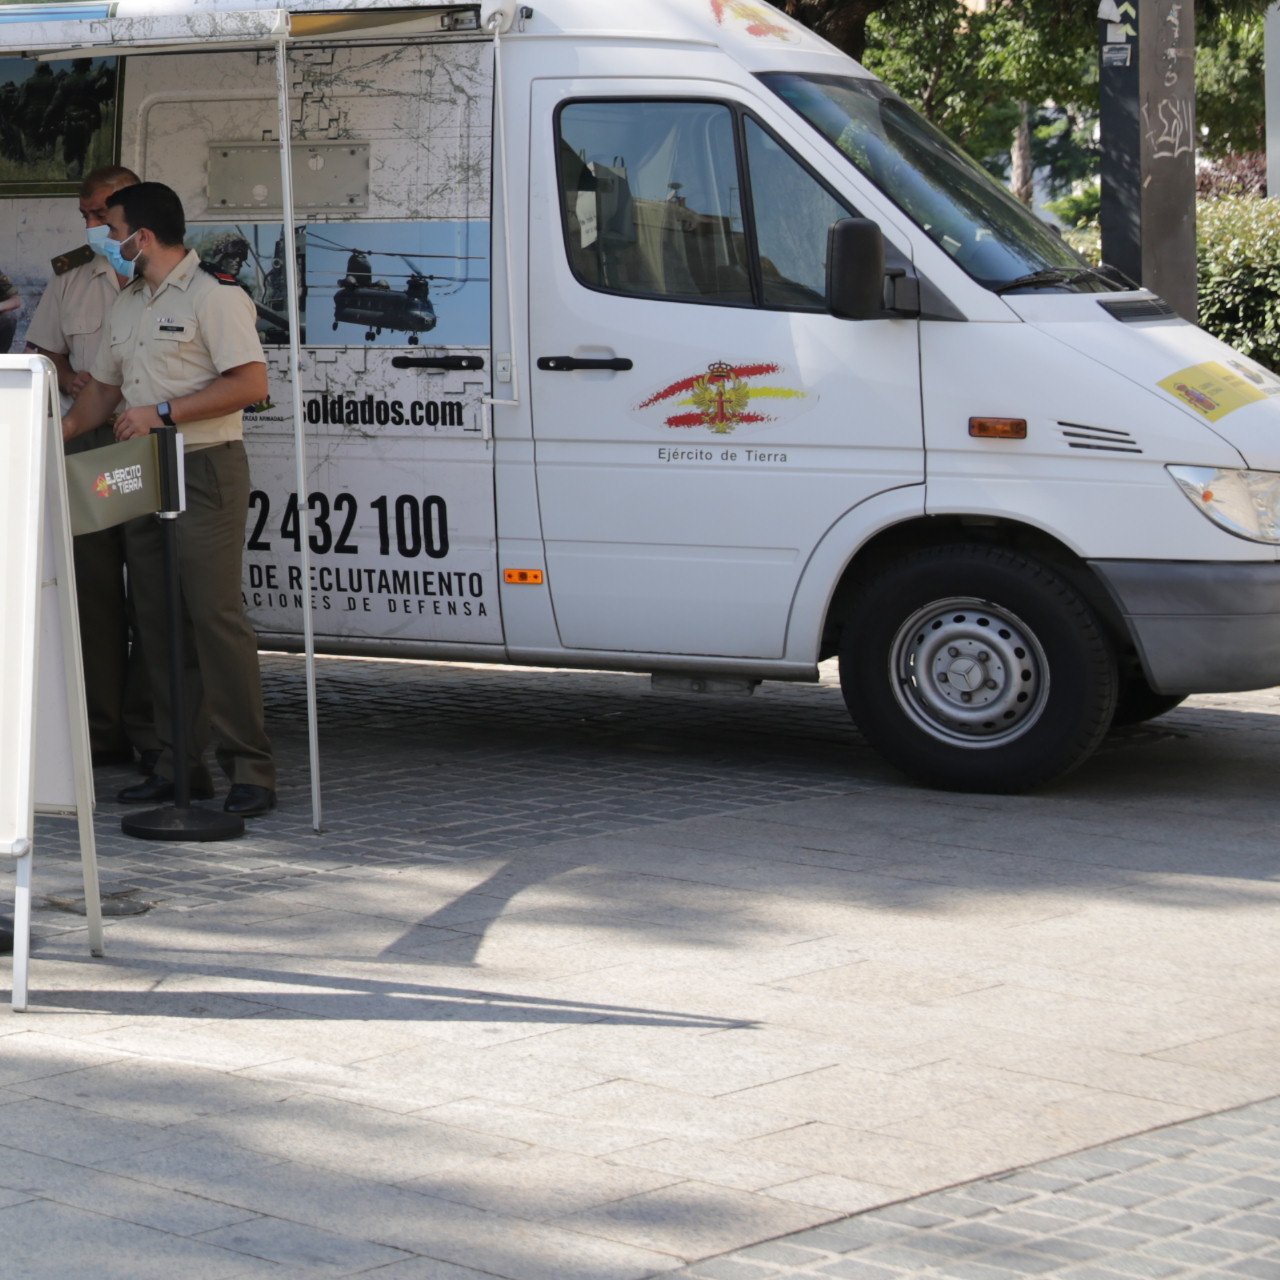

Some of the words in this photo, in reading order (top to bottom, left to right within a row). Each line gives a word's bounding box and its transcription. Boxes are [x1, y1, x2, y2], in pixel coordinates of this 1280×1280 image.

[658, 447, 713, 462] Ejército
[720, 450, 737, 461] de
[745, 450, 787, 462] Tierra
[117, 477, 143, 495] TIERRA
[280, 491, 359, 555] 432
[370, 494, 450, 559] 100
[249, 564, 279, 590] DE
[288, 565, 483, 598] RECLUTAMIENTO
[347, 596, 371, 612] DE
[388, 598, 487, 617] DEFENSA
